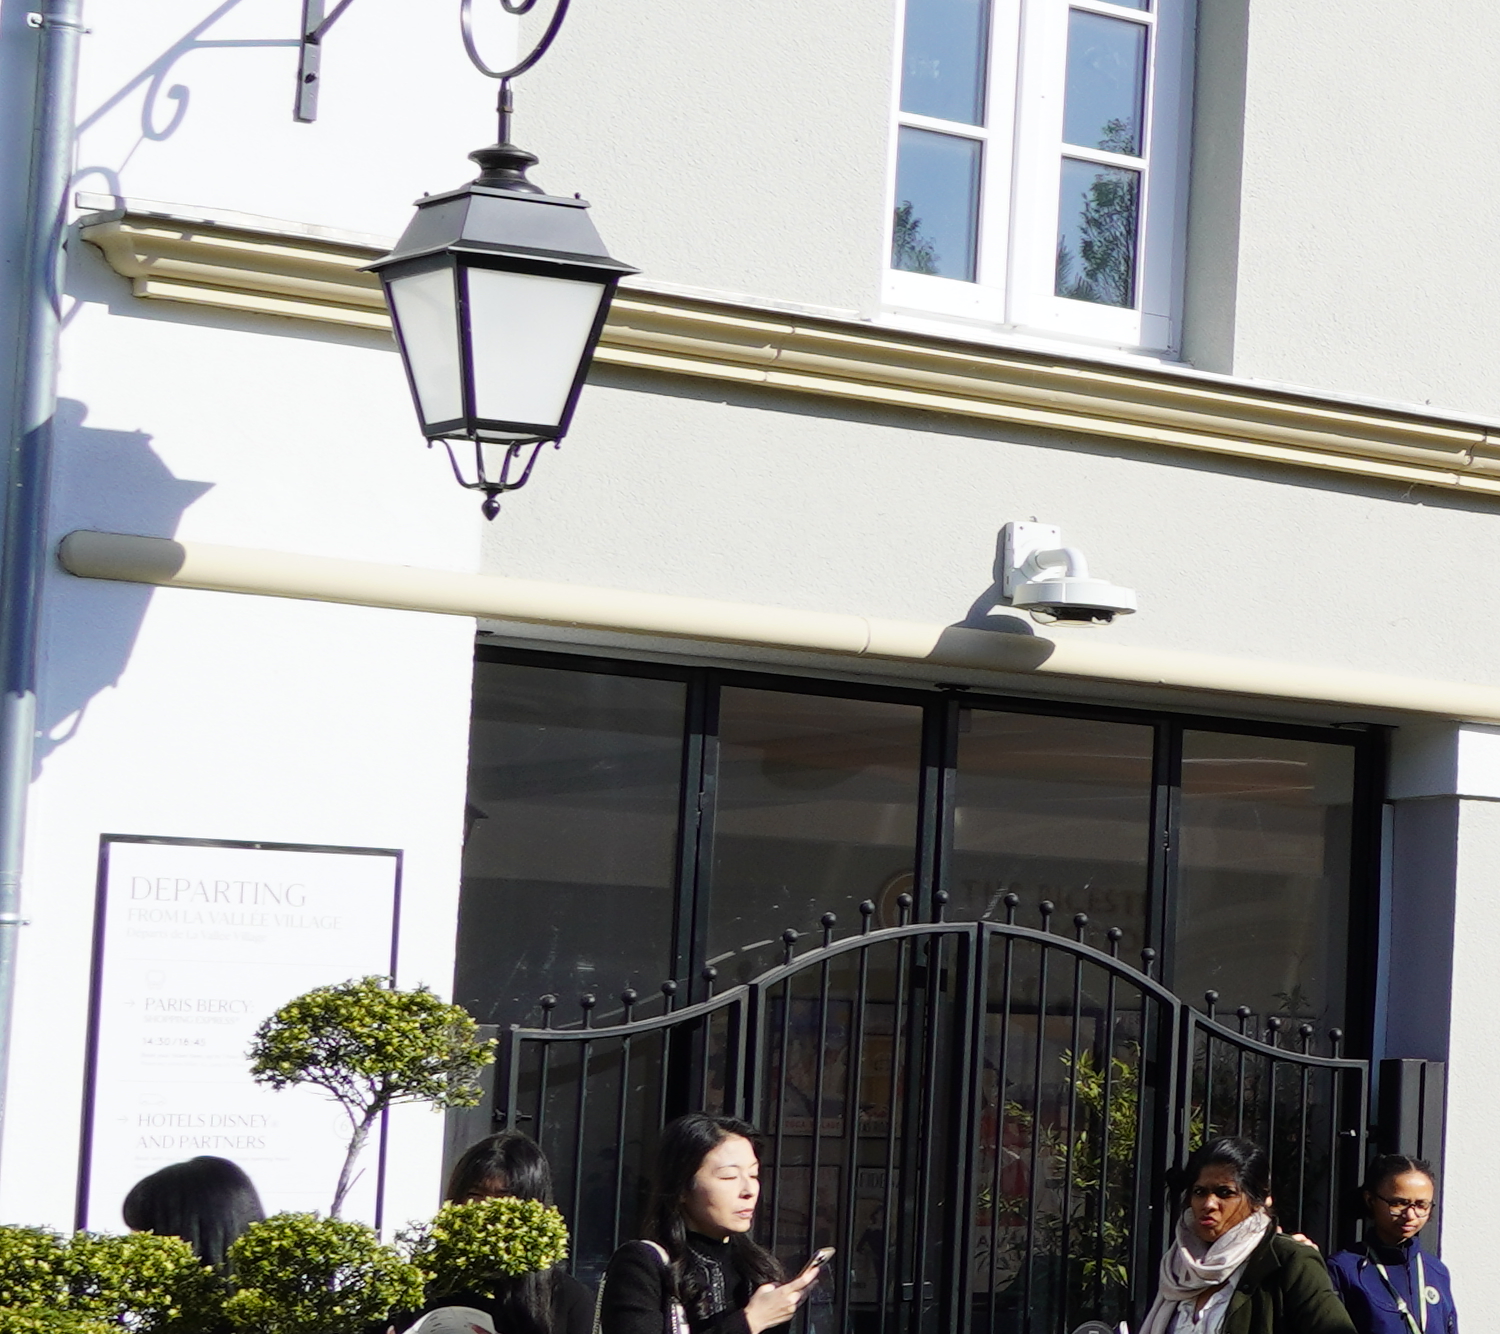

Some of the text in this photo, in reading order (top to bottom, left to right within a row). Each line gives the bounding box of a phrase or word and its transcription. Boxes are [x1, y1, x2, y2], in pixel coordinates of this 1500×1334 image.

[130, 876, 307, 908] DEPARTING
[127, 907, 343, 930] FROM LA VALLÉE VILLAGE
[145, 997, 192, 1012] PARIS
[137, 1113, 206, 1128] HOTELS
[136, 1135, 267, 1150] AND PARTNERS
